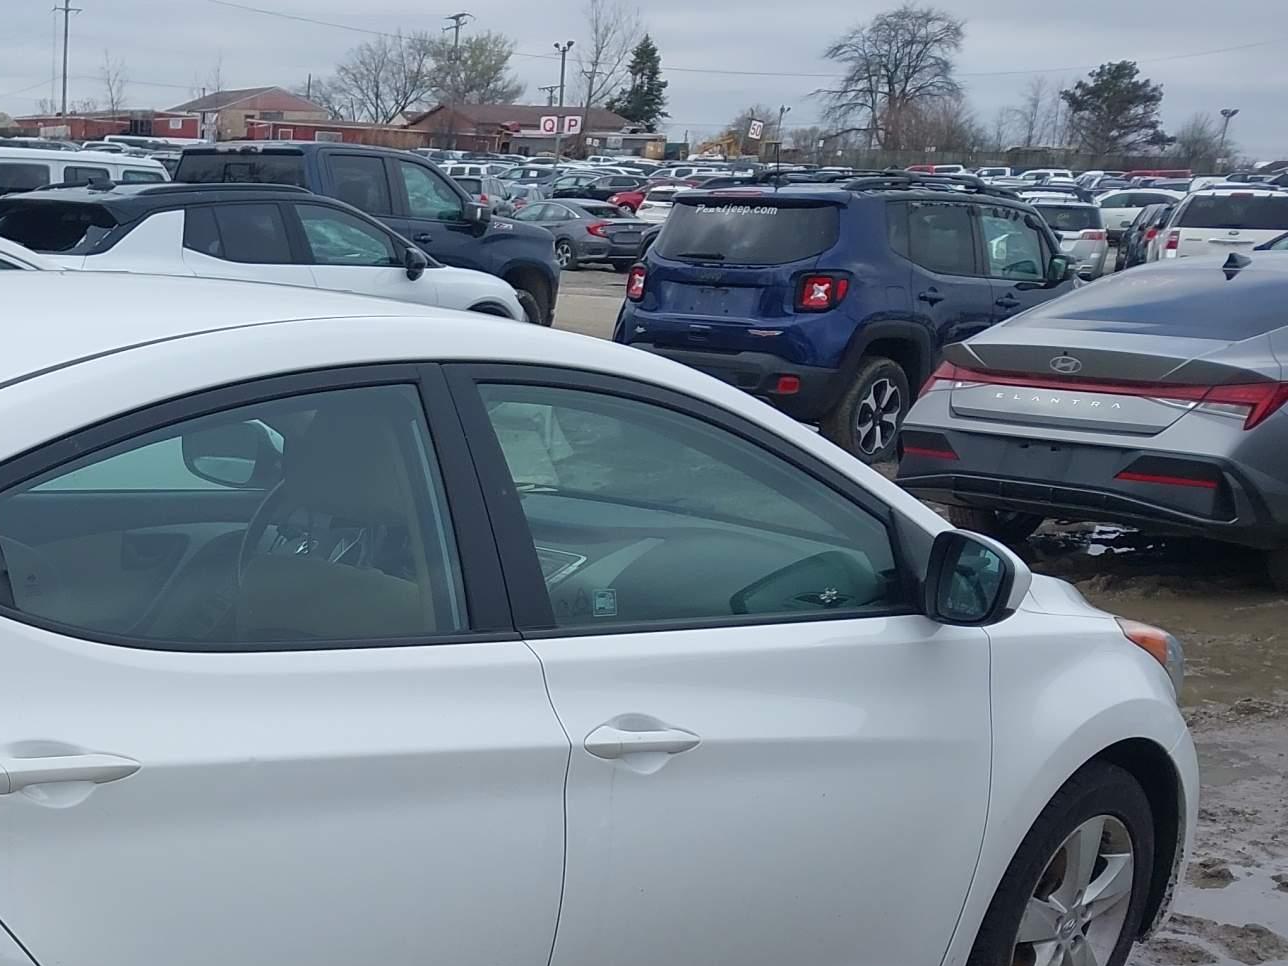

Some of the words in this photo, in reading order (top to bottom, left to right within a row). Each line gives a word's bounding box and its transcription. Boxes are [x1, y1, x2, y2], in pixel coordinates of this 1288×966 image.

[543, 118, 555, 132] Q
[568, 118, 578, 132] P
[750, 123, 762, 136] 50
[995, 392, 1121, 409] ELANTRA
